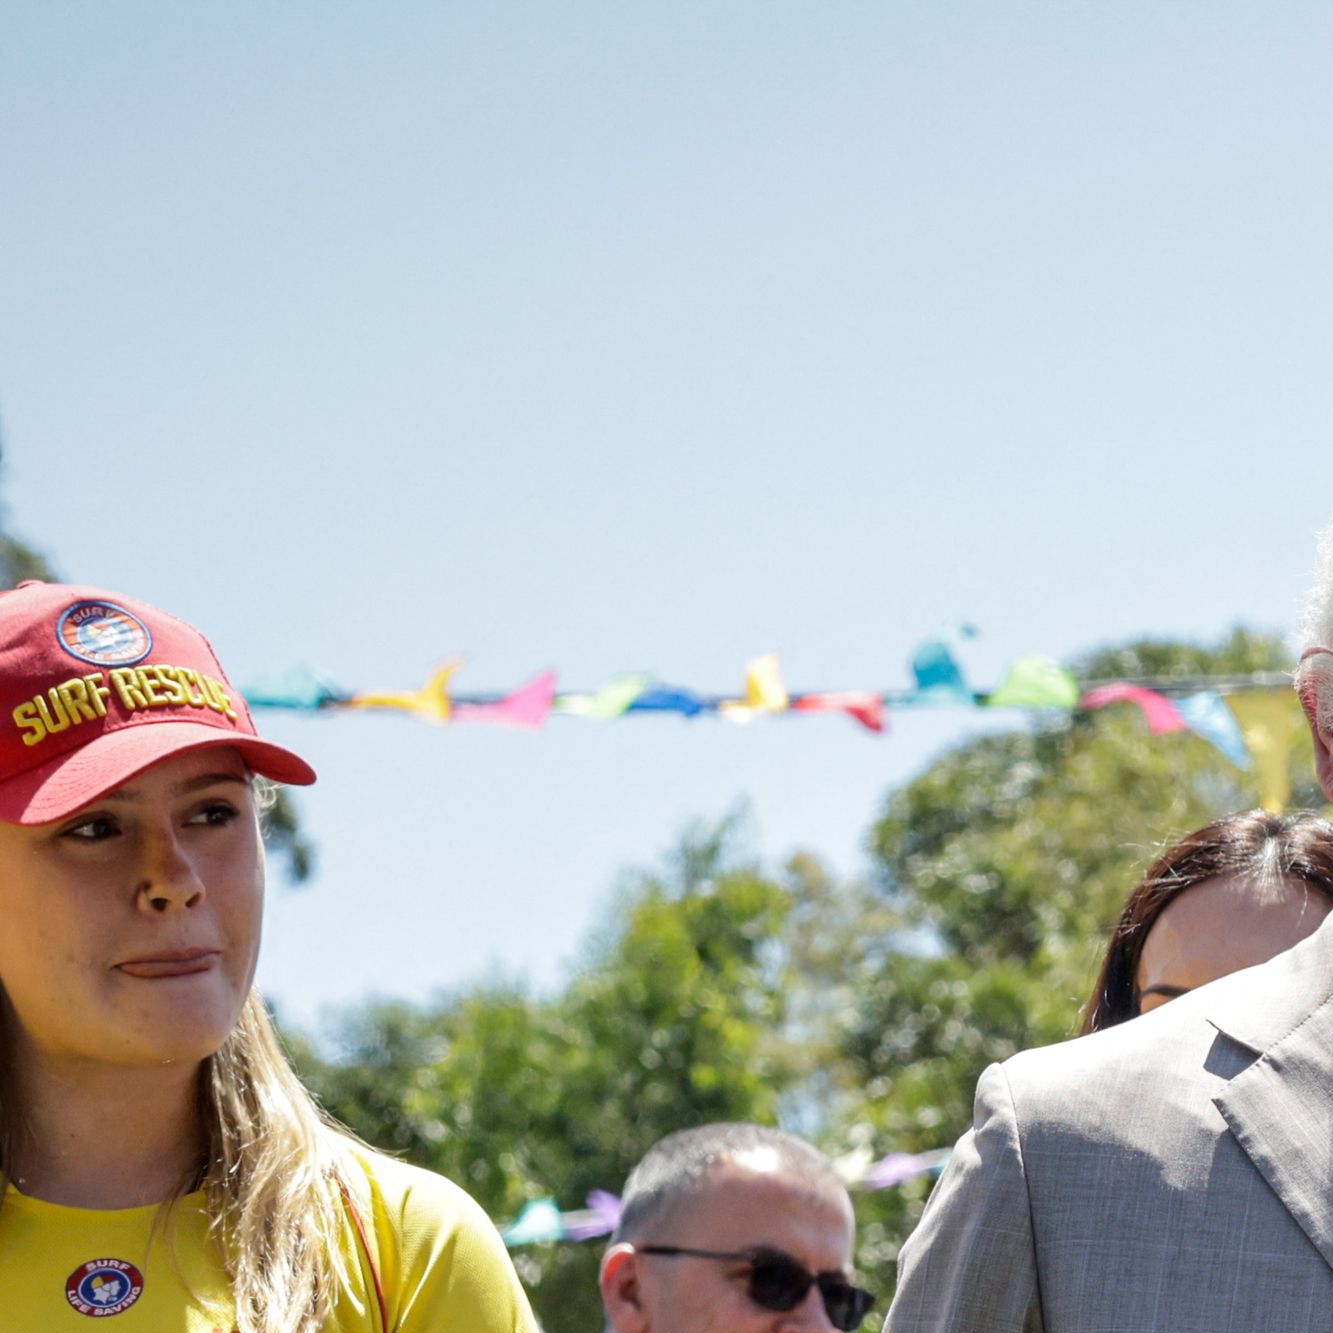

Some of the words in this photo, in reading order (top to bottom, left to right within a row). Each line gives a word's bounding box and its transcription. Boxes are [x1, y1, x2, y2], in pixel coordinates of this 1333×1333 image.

[12, 673, 110, 746] SURF
[110, 665, 237, 719] RESCUE
[86, 1259, 131, 1272] SURF
[68, 1289, 92, 1314] LIFE
[94, 1286, 141, 1316] SAVING
